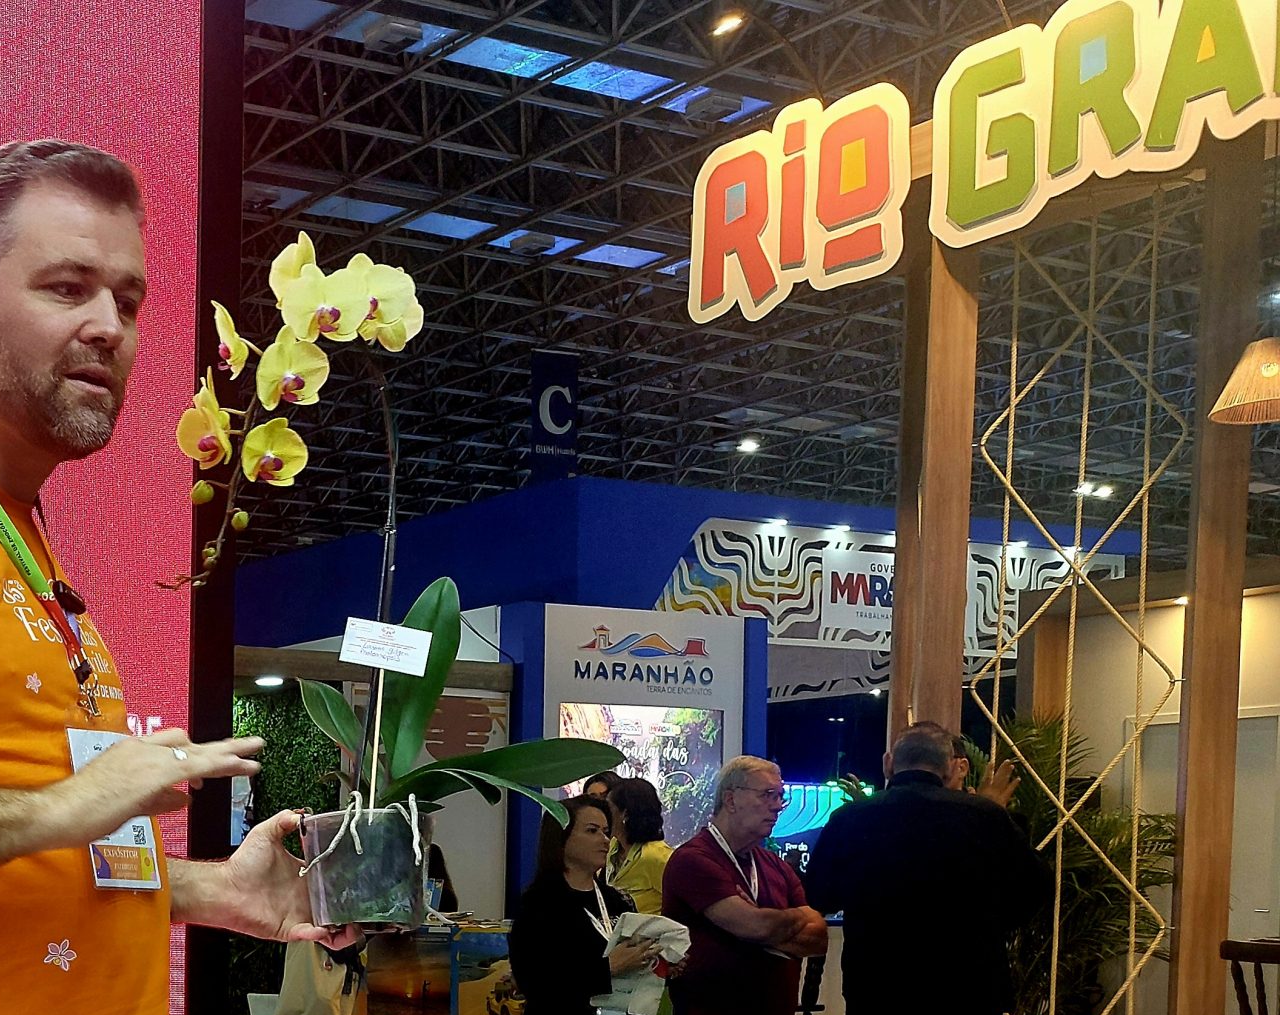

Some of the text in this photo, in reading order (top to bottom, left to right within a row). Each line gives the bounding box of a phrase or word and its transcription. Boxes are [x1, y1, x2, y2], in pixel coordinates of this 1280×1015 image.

[944, 0, 1280, 232] GRA
[539, 385, 572, 435] C
[574, 659, 714, 686] MARANHÃO
[647, 685, 713, 697] TERRA DE ENCANTOS
